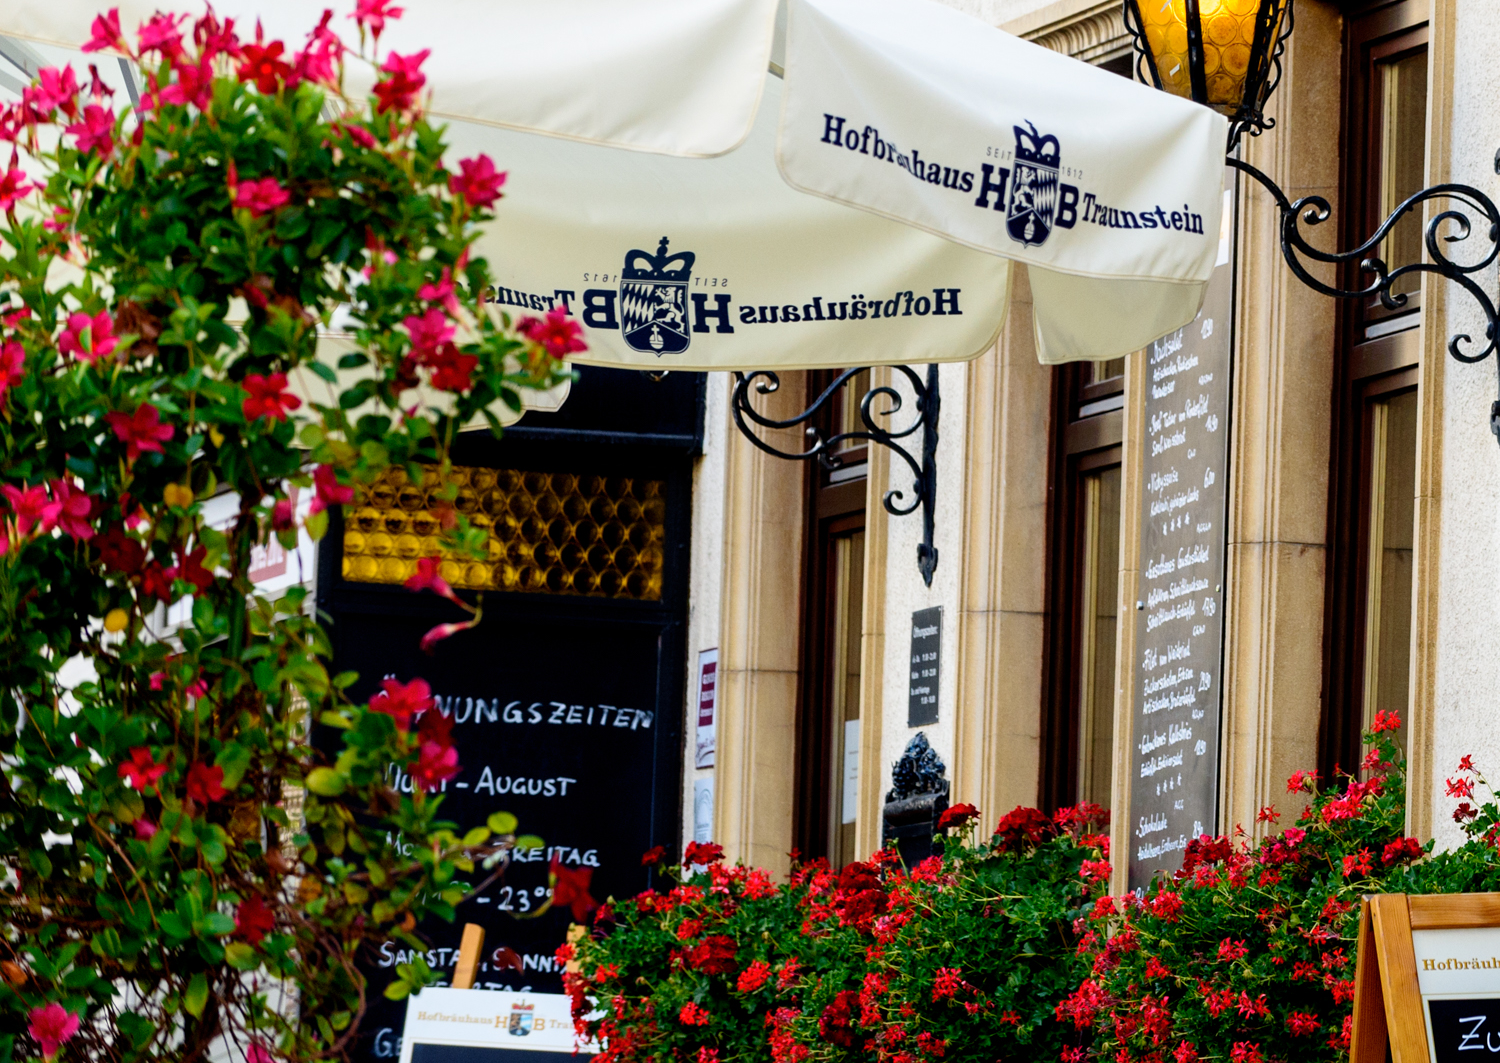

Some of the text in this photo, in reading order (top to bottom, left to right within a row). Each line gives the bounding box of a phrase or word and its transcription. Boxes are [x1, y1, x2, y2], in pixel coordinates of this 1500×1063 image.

[986, 146, 1083, 181] SEIT 1612
[1081, 193, 1204, 235] Traunstein
[378, 673, 653, 731] NUNGSZEITEN
[474, 765, 577, 796] AUGUST
[417, 1011, 493, 1025] Hofbräuhaus
